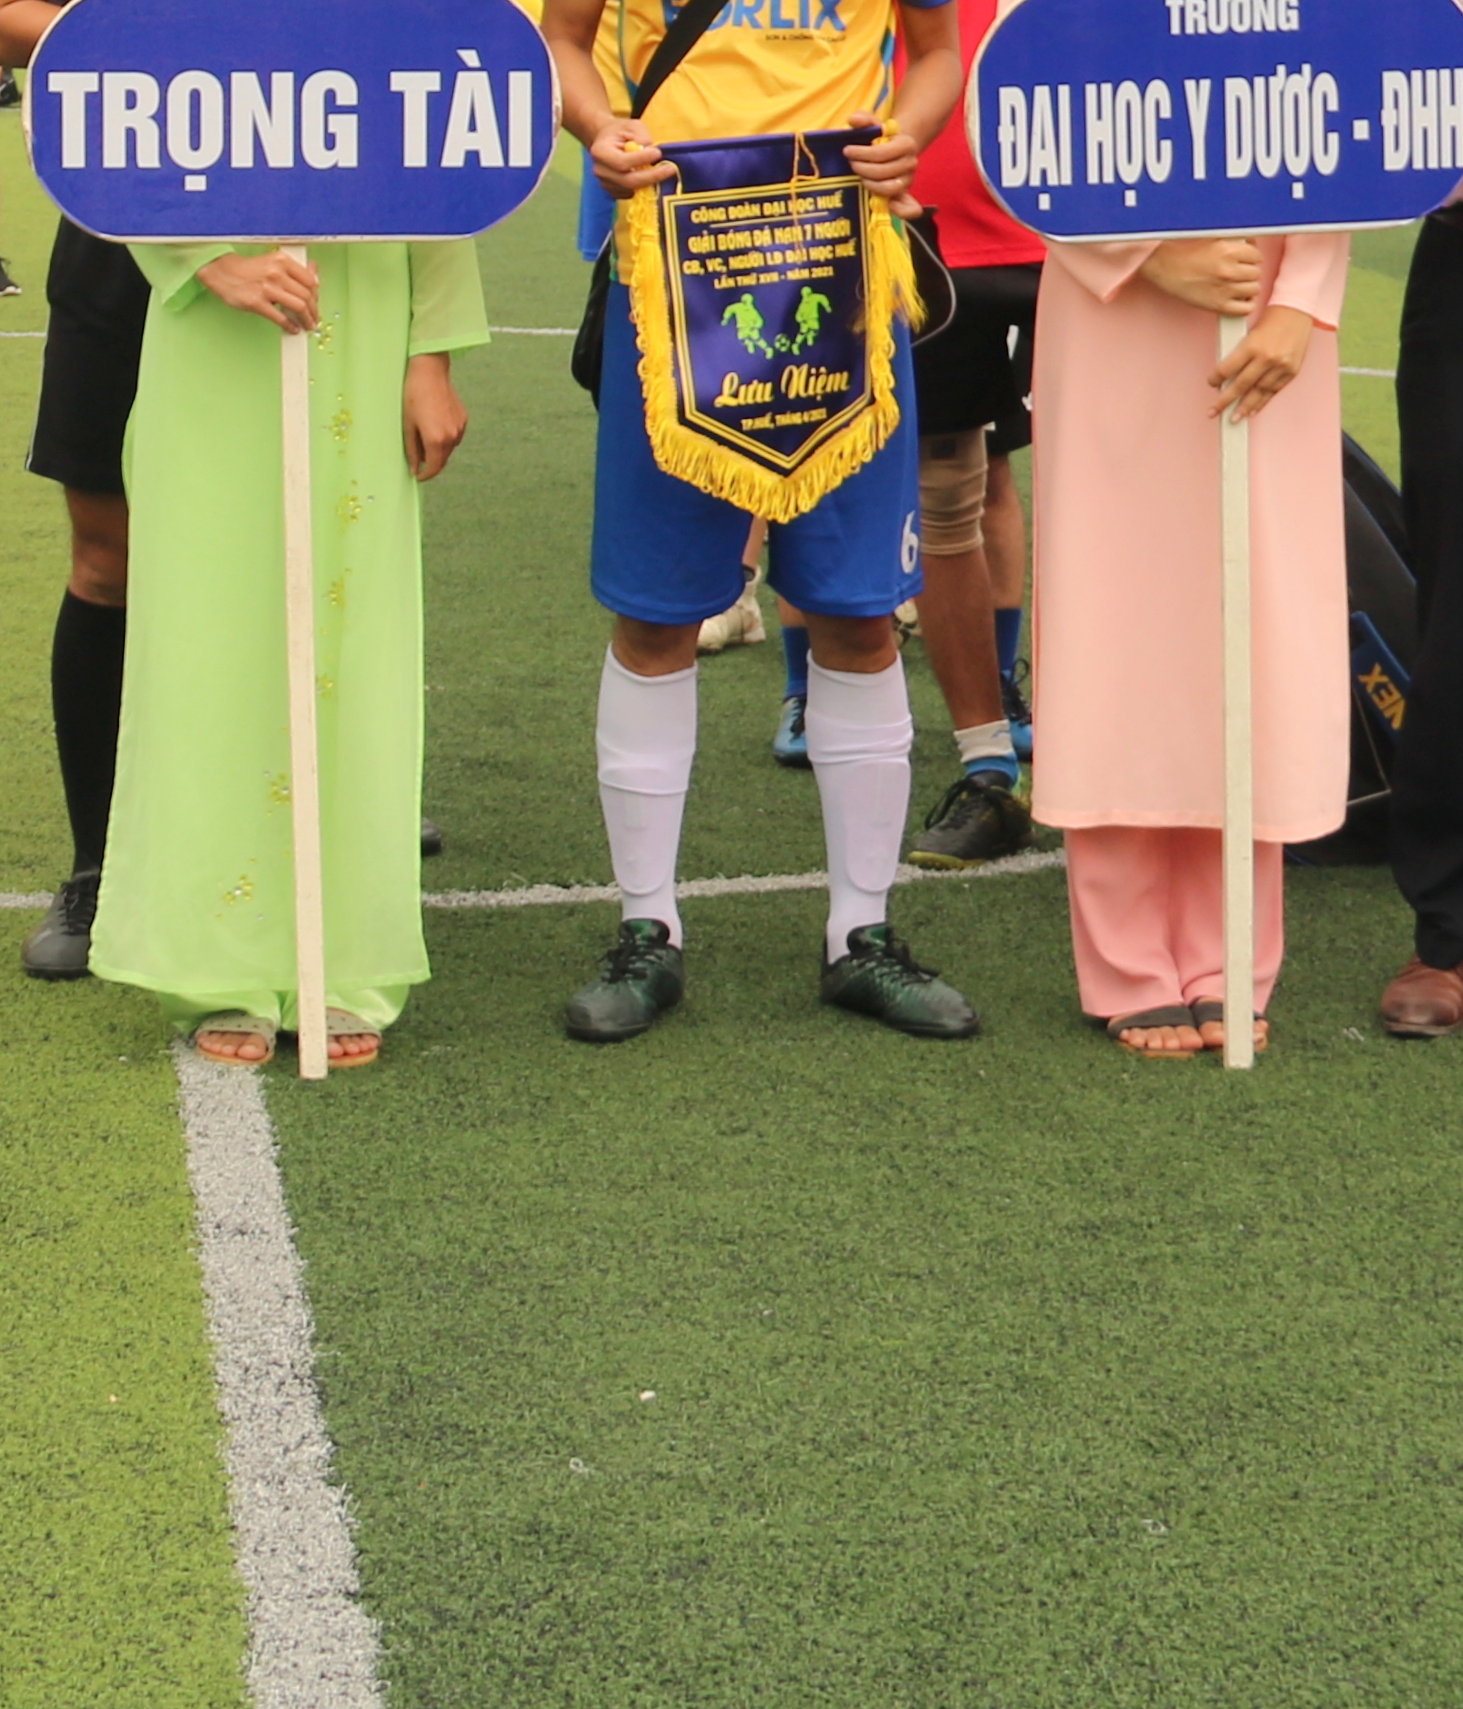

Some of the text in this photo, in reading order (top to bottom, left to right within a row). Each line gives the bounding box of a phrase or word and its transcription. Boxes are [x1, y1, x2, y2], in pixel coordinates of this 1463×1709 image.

[47, 49, 533, 190] TRỌNG TÀI
[998, 84, 1071, 210] ĐẠI
[1085, 78, 1171, 207] HỌC
[1184, 78, 1211, 179] Y
[1225, 64, 1339, 199] DƯỢC
[1353, 119, 1370, 140] -
[691, 206, 726, 223] CÔNG
[728, 202, 761, 219] ĐOÀN
[817, 190, 843, 209] HUẾ
[688, 230, 715, 253] GIẢI
[717, 229, 751, 250] BÓNG
[804, 224, 813, 240] 7
[835, 238, 857, 257] HUẾ
[714, 363, 850, 408] Lưu Niệm
[900, 512, 920, 574] 6
